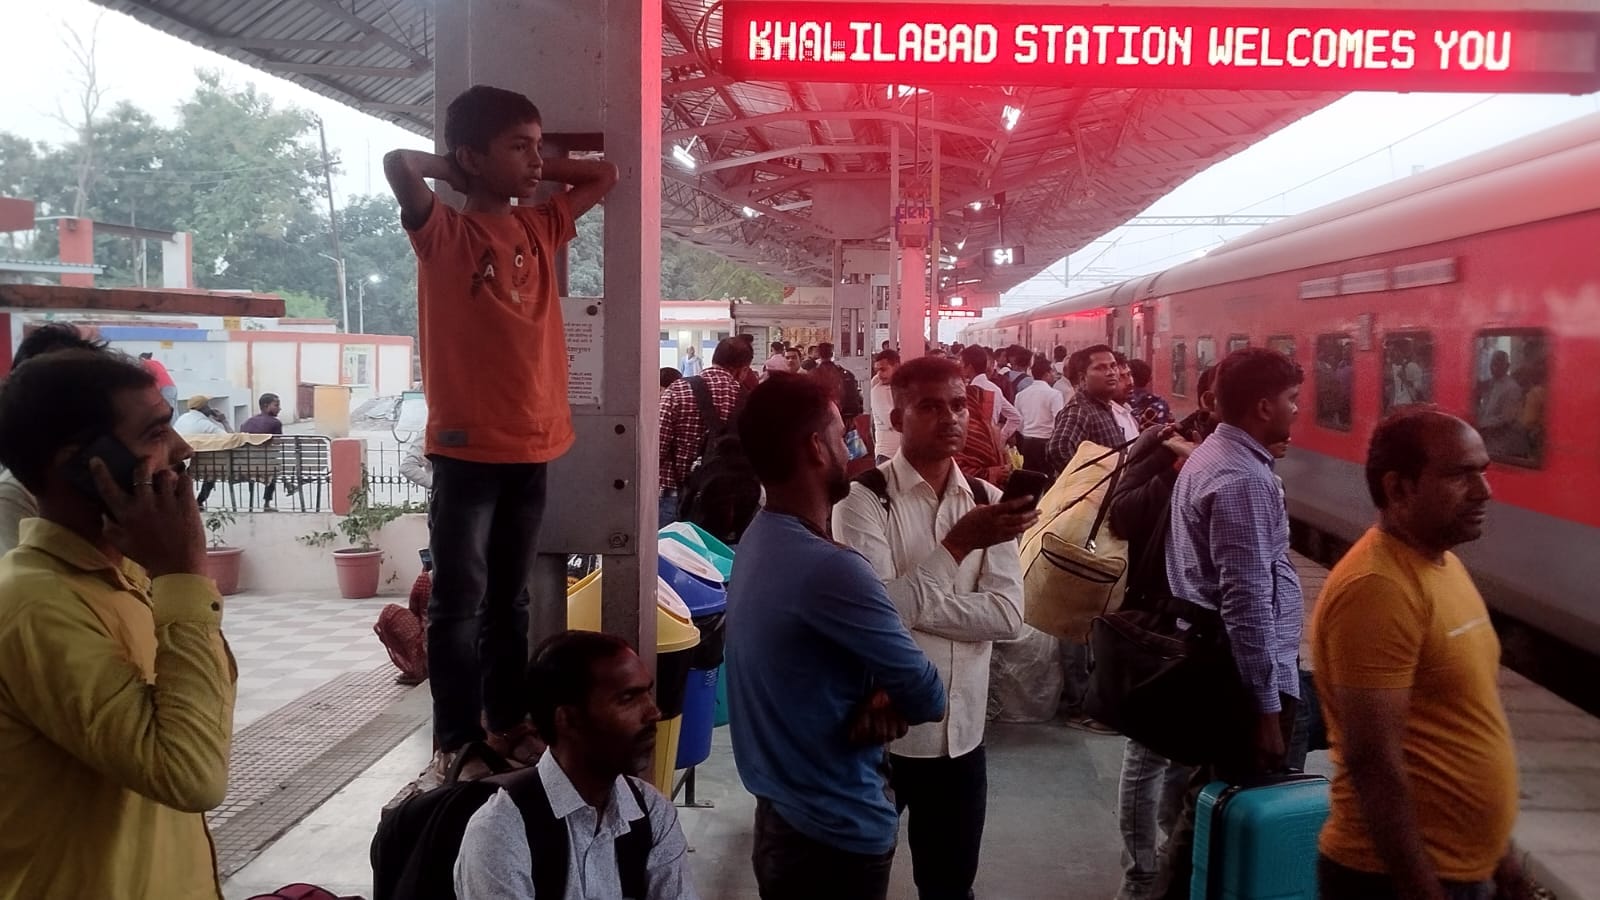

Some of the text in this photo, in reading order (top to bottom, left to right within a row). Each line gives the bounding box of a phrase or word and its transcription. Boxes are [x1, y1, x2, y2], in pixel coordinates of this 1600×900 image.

[748, 19, 1511, 71] KHALILABAD STATION WELCOMES YOU
